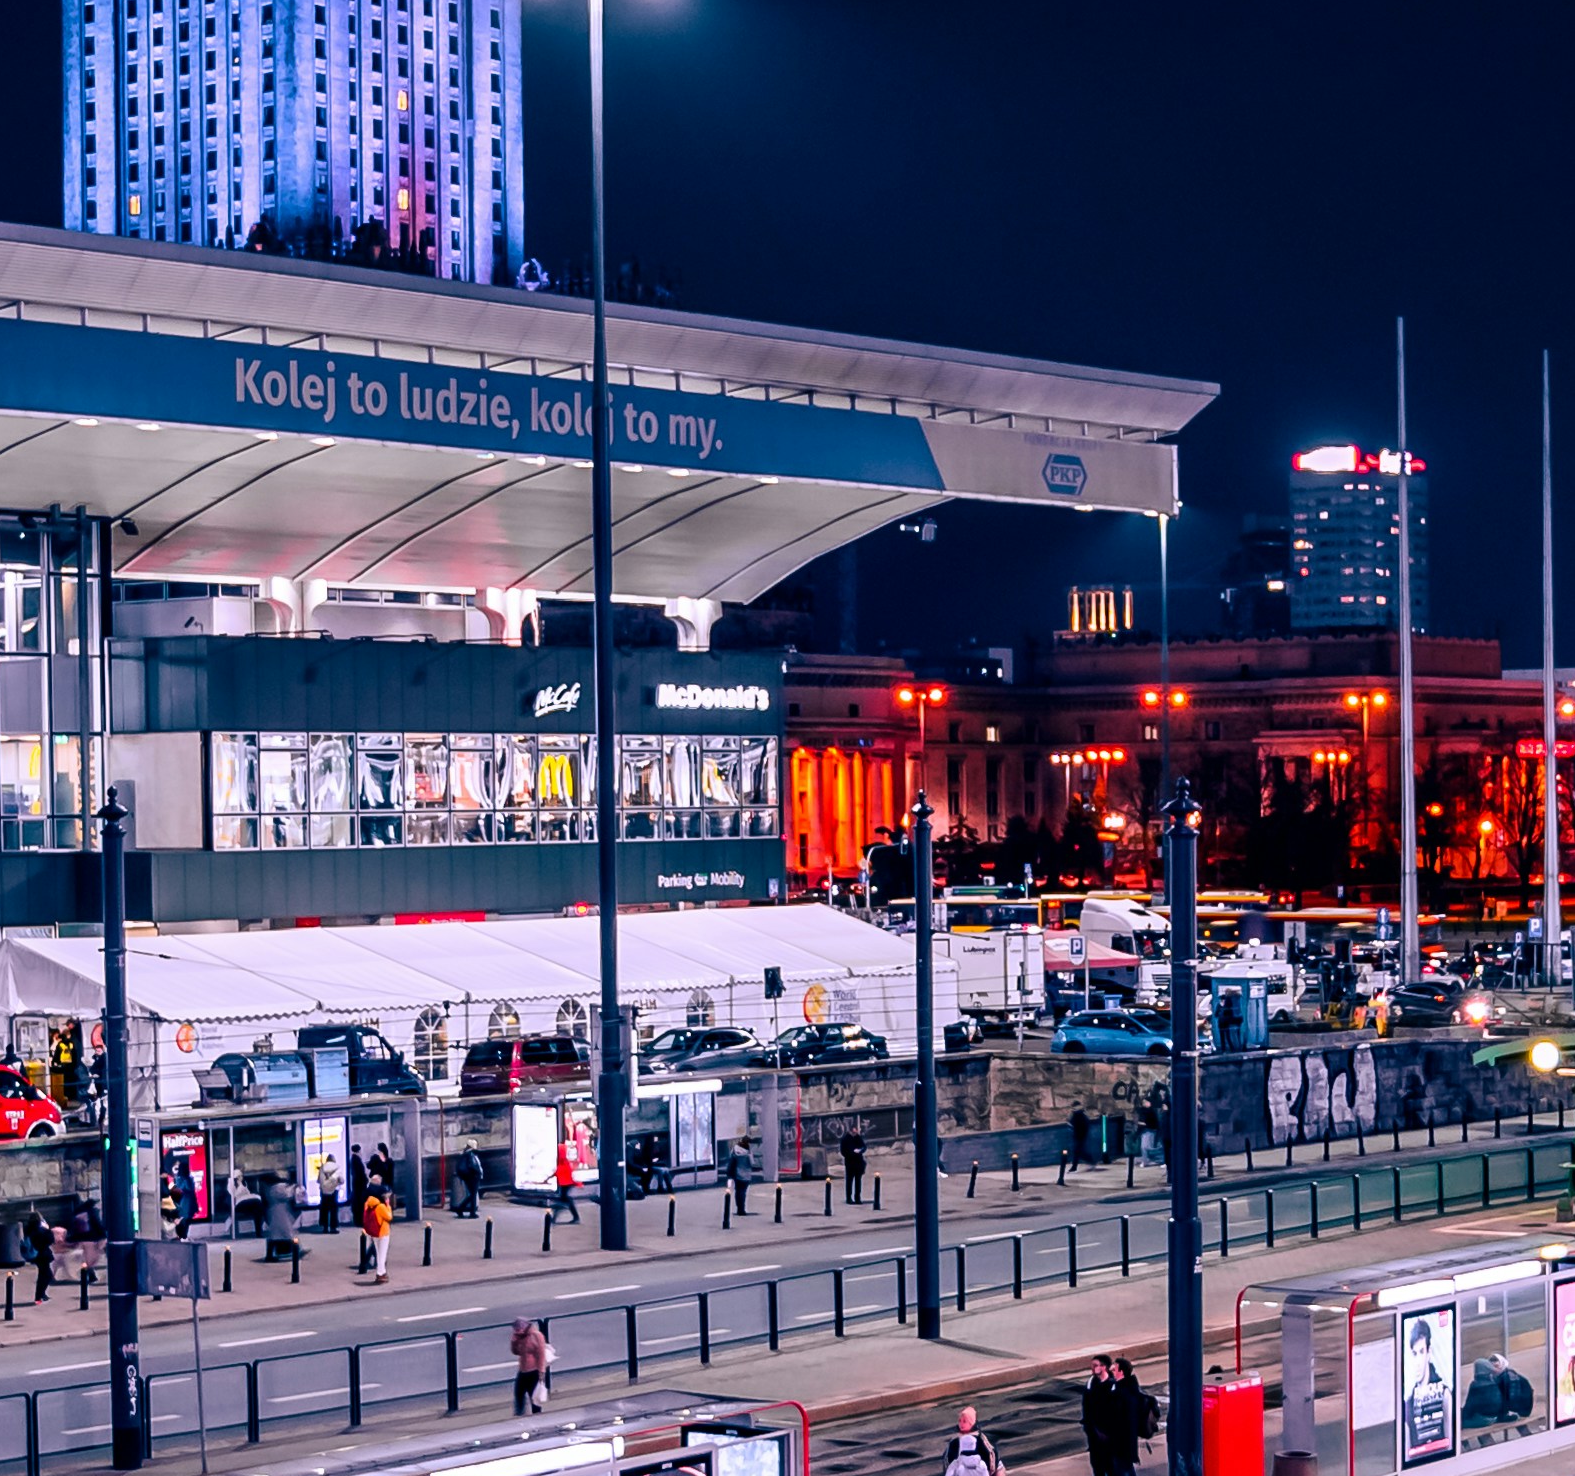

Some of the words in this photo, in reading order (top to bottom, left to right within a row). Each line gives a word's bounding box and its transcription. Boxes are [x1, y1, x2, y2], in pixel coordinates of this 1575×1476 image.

[235, 357, 337, 423] Kolej
[347, 371, 388, 417] to
[400, 372, 521, 440] ludzie,
[624, 402, 659, 444] to
[669, 413, 724, 460] my.
[1050, 465, 1083, 484] PKP
[655, 683, 770, 711] McDonald's
[657, 874, 693, 890] Parking
[710, 871, 745, 889] Mobility
[162, 1134, 205, 1149] HalfPrice
